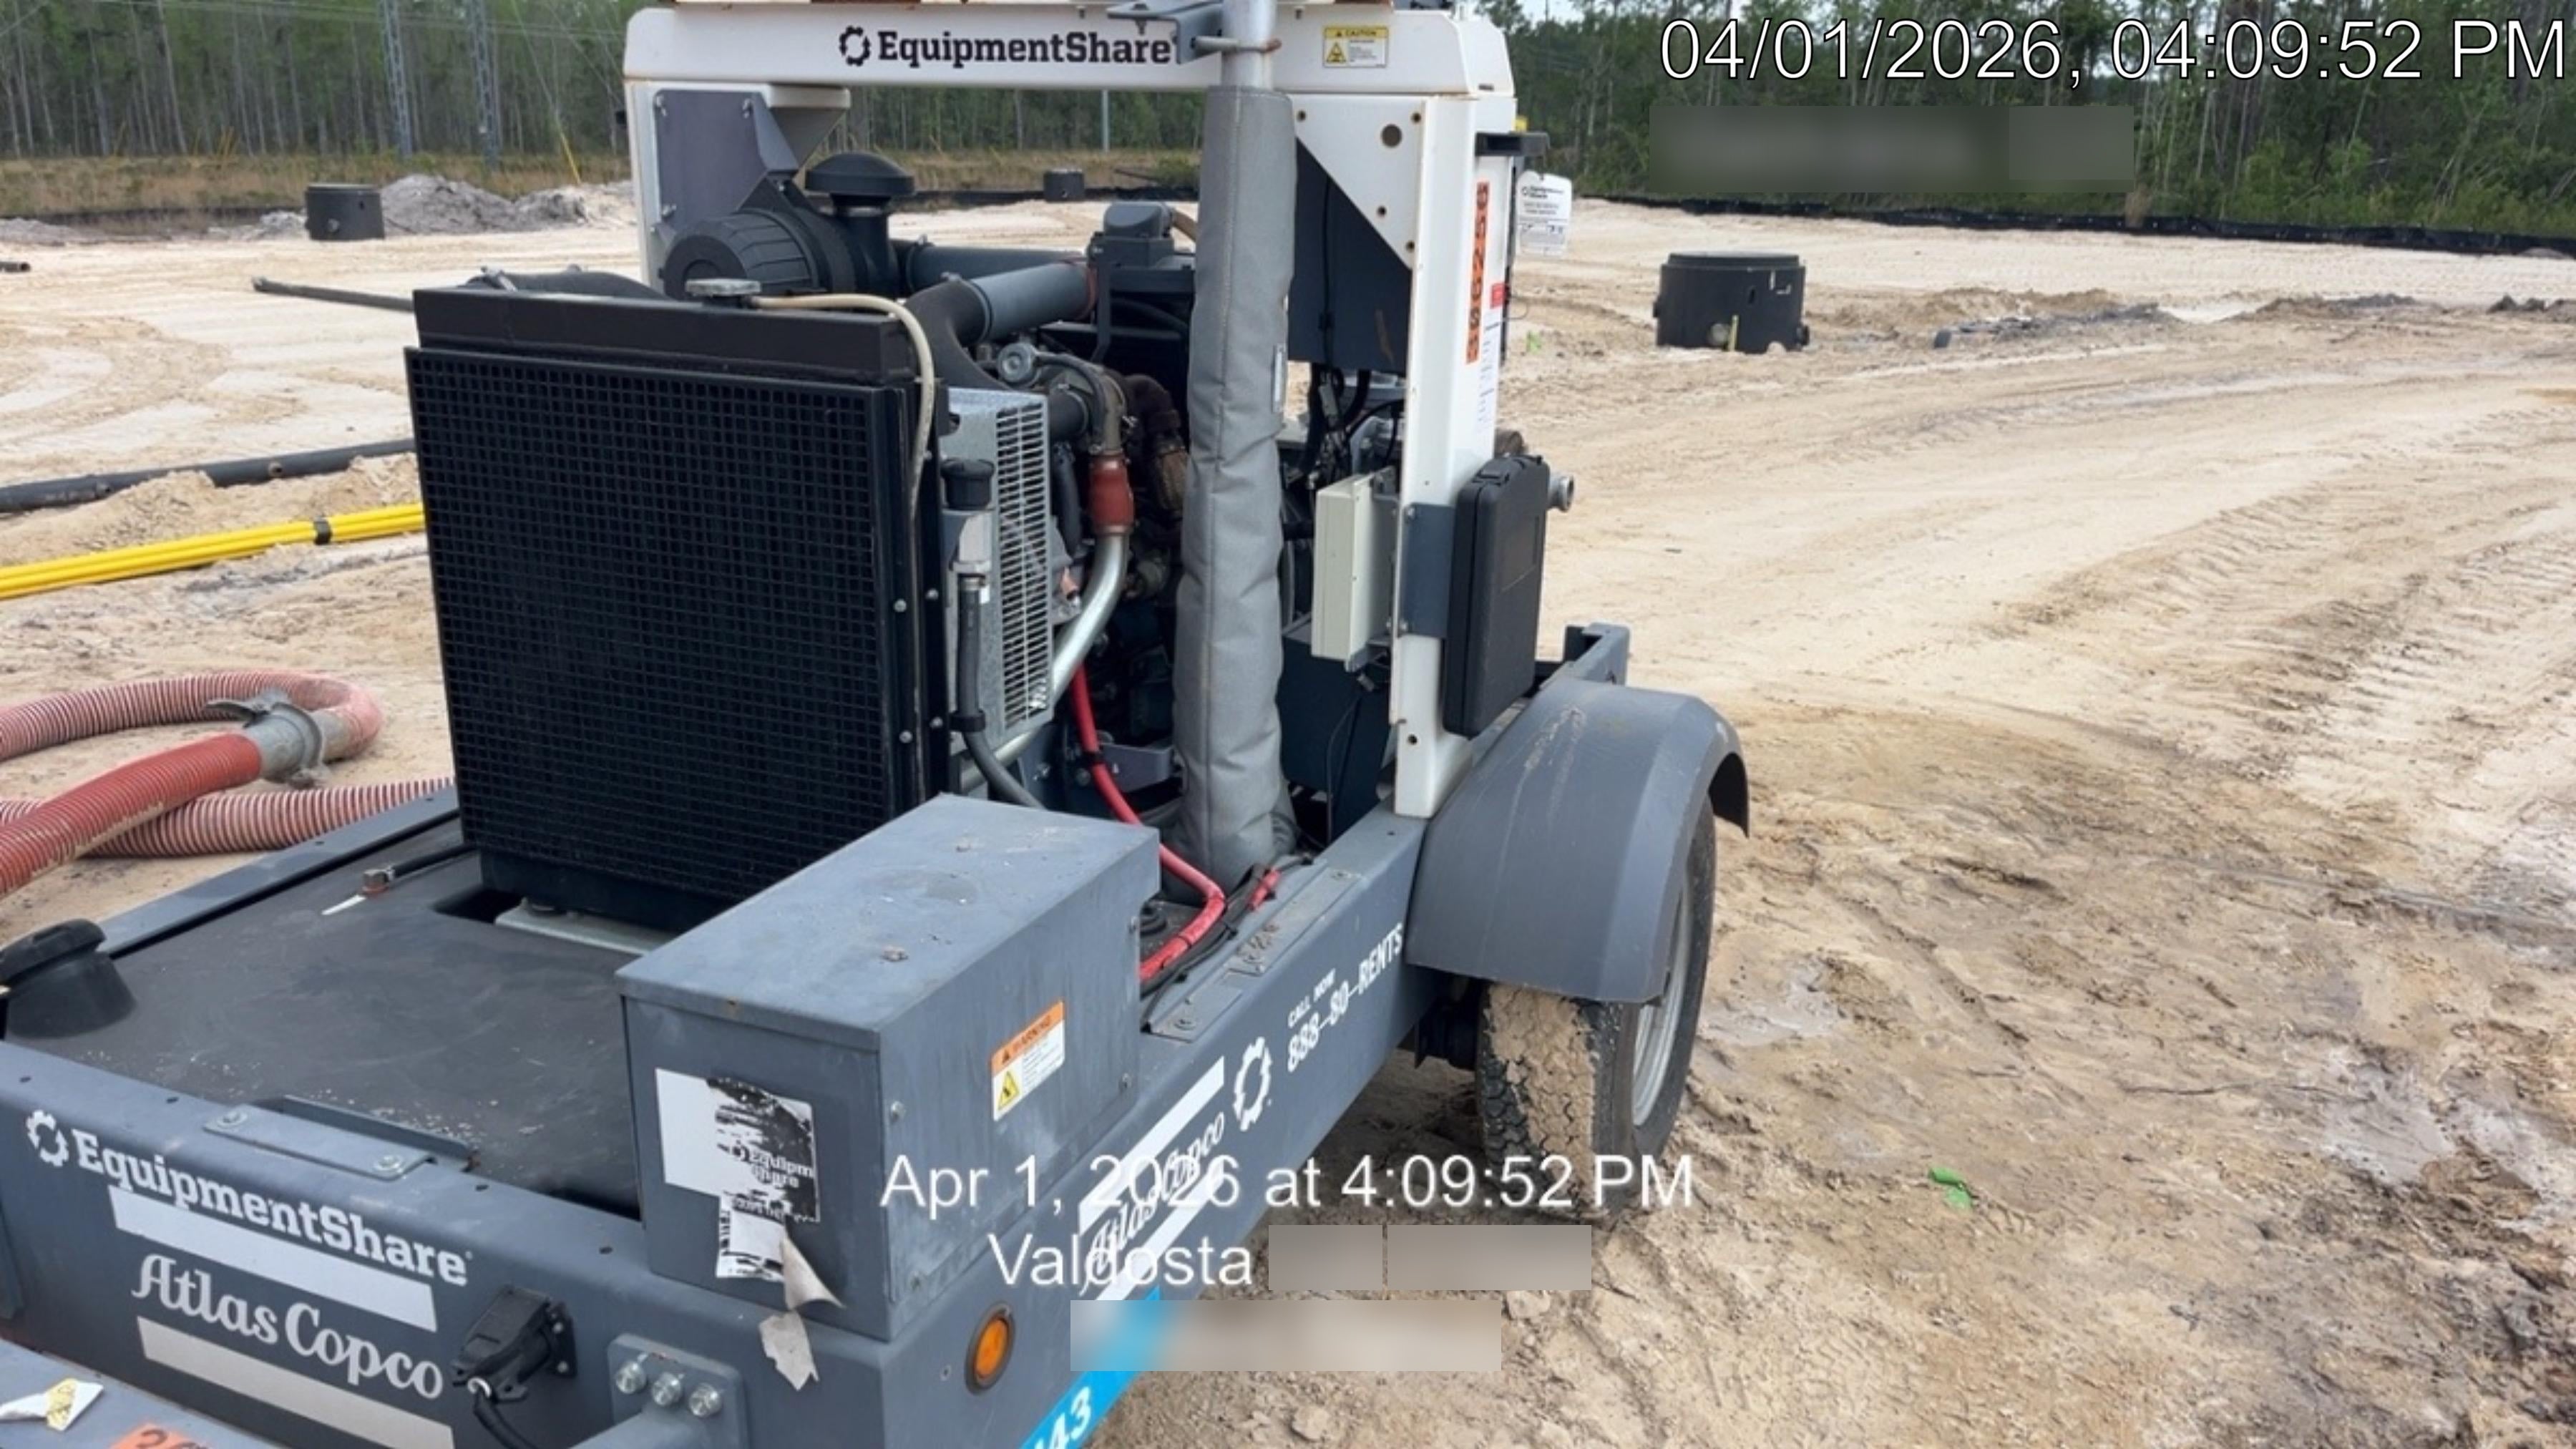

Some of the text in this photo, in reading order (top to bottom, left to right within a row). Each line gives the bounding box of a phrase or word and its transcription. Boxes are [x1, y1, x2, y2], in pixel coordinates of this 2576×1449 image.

[877, 30, 1171, 69] EquipmentShare
[72, 1128, 468, 1287] EquipmentShare
[131, 1254, 444, 1400] Atlas Copco
[1035, 1385, 1092, 1449] 43
